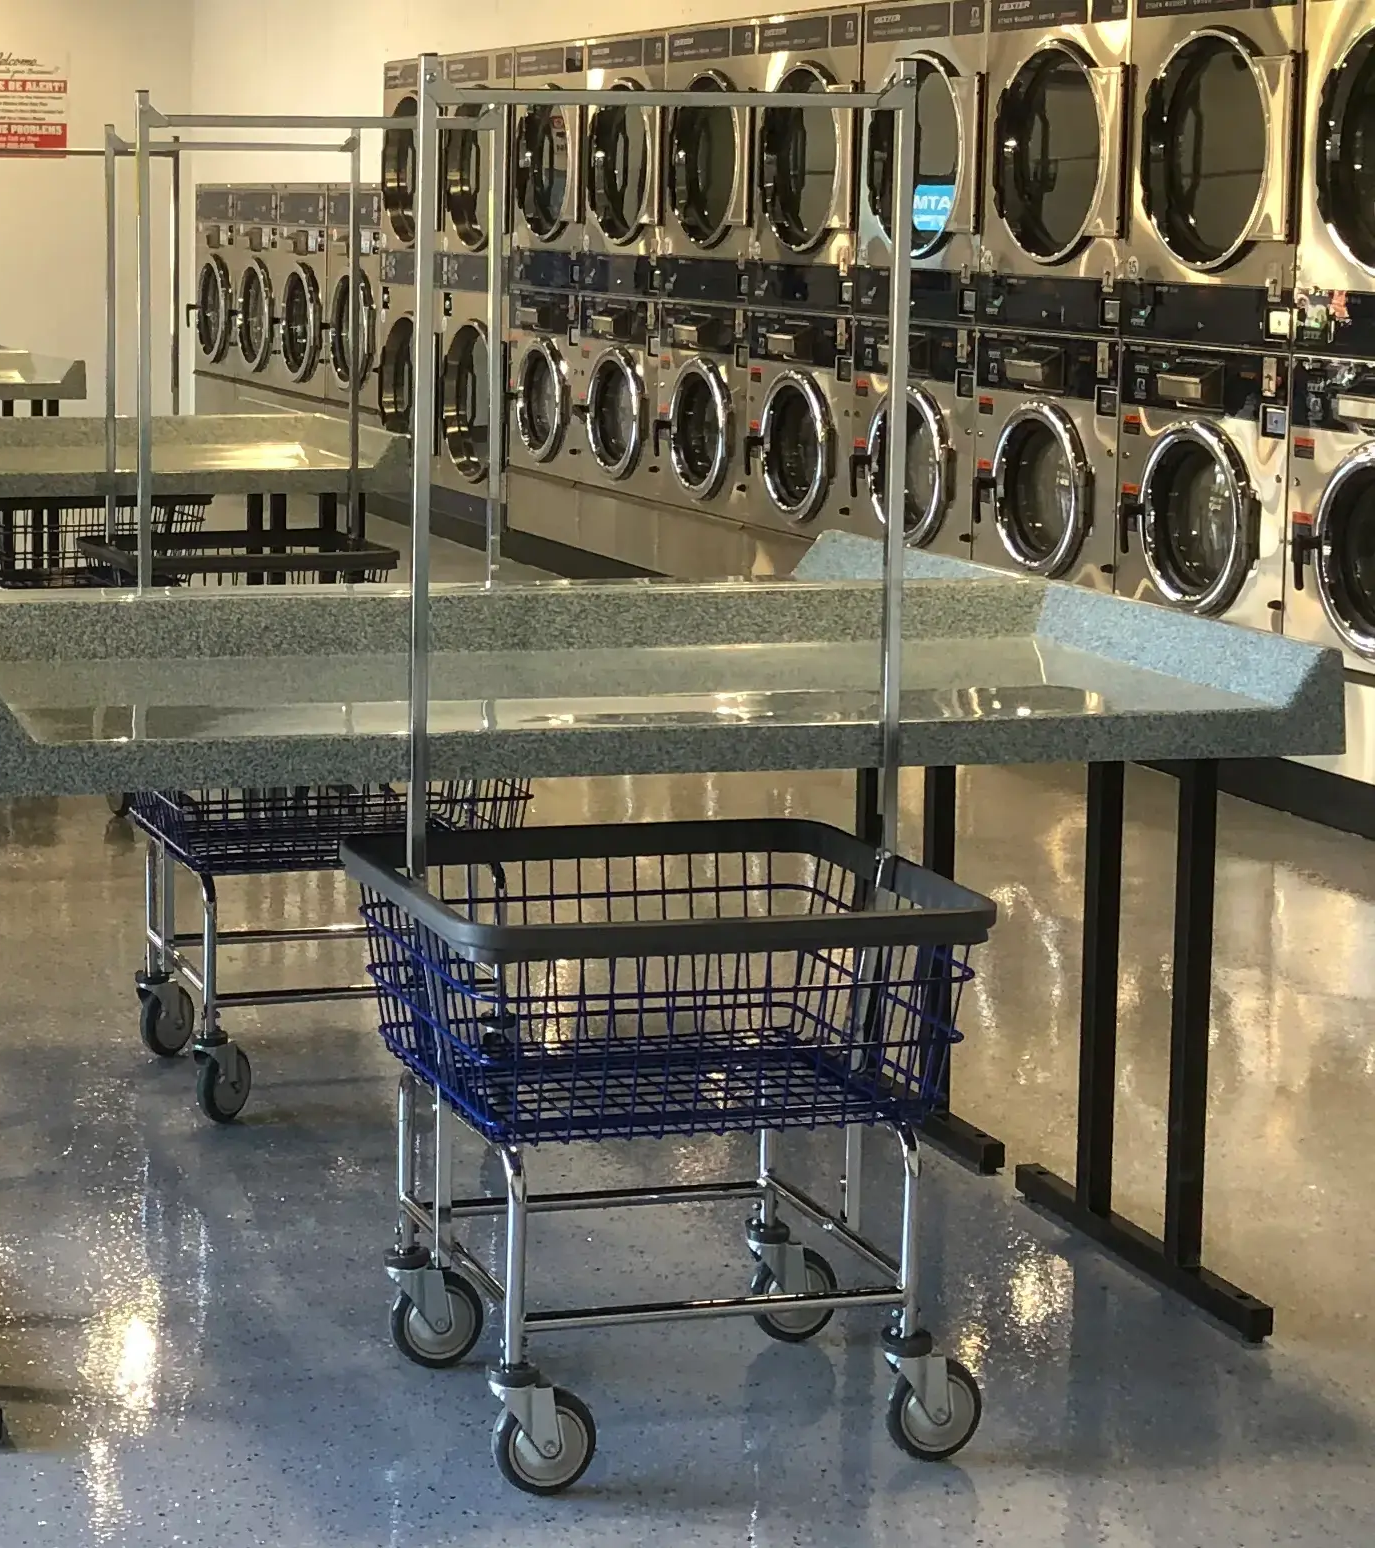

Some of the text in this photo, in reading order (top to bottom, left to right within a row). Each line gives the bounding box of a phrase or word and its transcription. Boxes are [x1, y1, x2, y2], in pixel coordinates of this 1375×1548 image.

[999, 1, 1030, 11] DEXTER
[874, 14, 901, 24] DEXTER
[8, 80, 23, 91] BE
[25, 81, 64, 91] ALERT!
[11, 125, 62, 135] PROBLEMS
